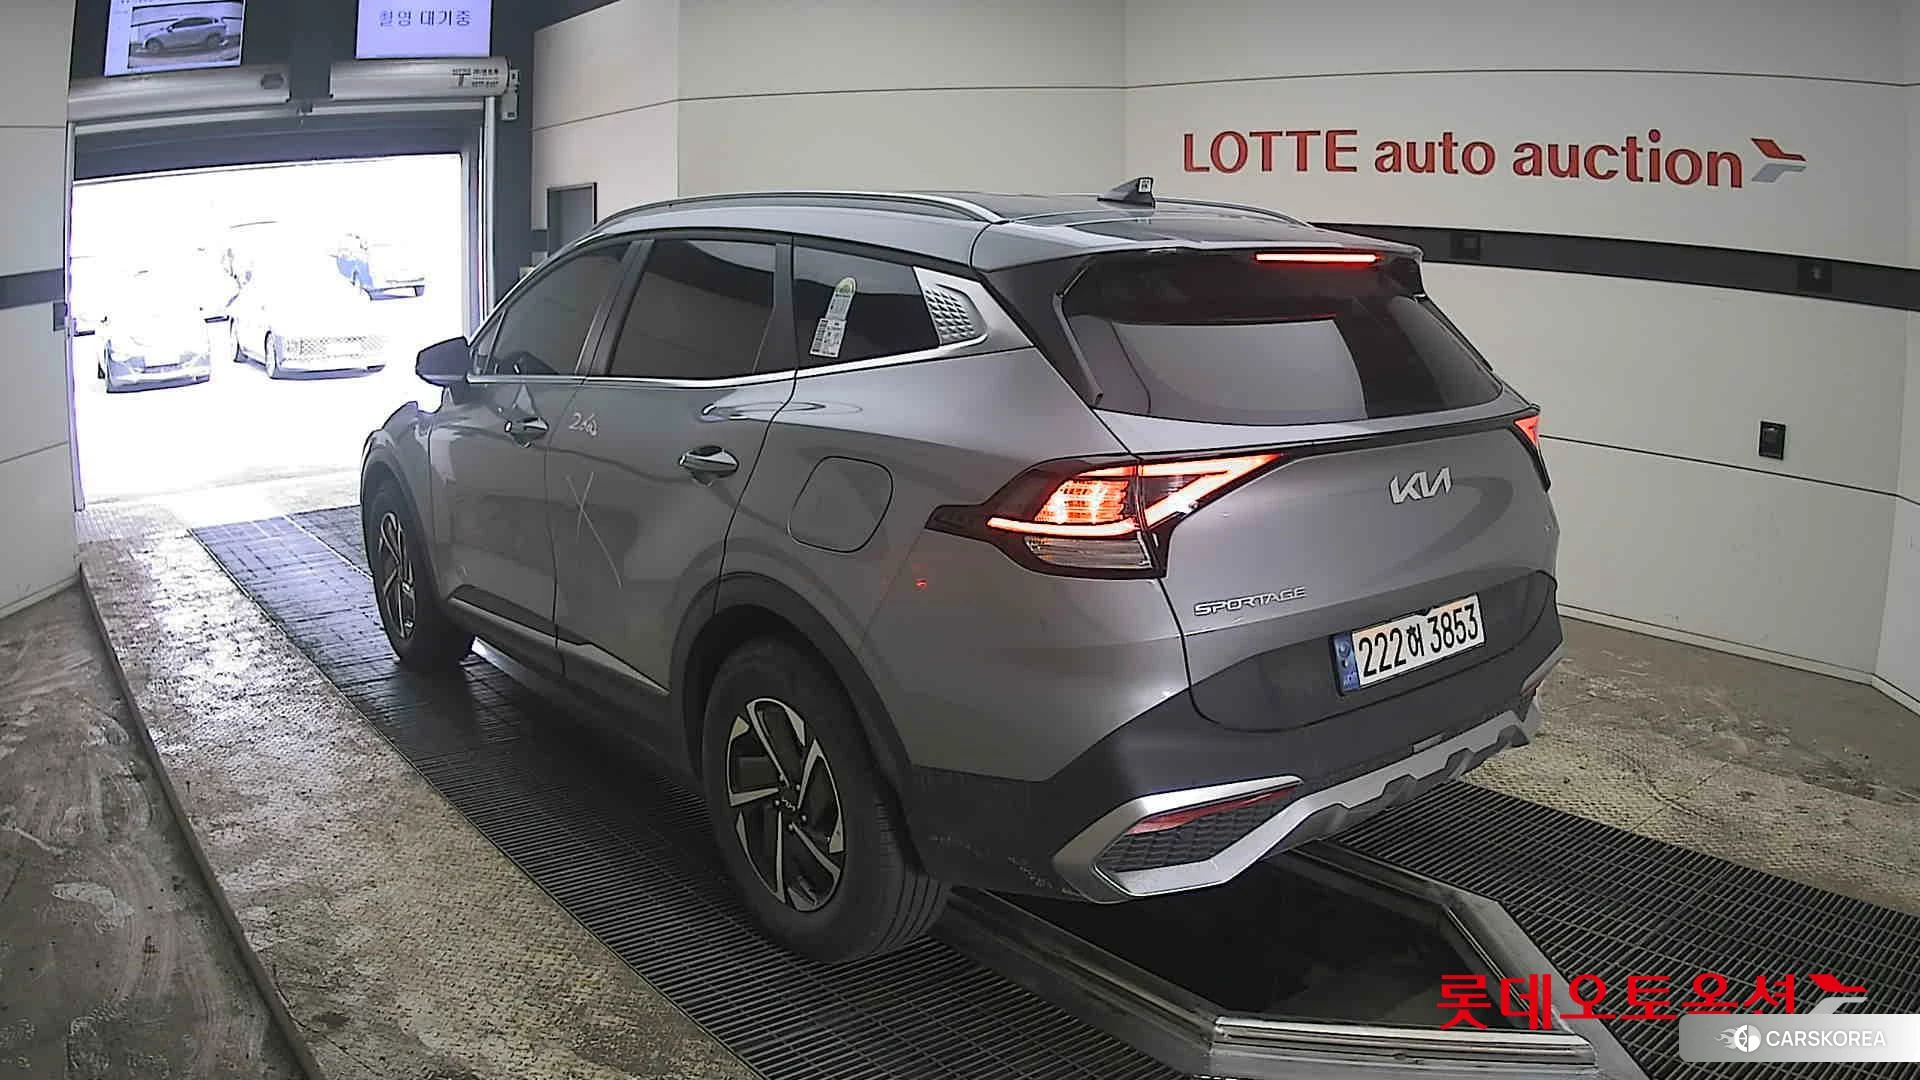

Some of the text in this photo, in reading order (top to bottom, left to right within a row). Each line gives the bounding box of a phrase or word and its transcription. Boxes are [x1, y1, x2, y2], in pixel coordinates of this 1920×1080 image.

[1183, 128, 1743, 189] LOTTE auto auction
[1390, 467, 1452, 504] KIA
[1194, 586, 1306, 616] SPORTAGE
[1427, 603, 1479, 653] 3853
